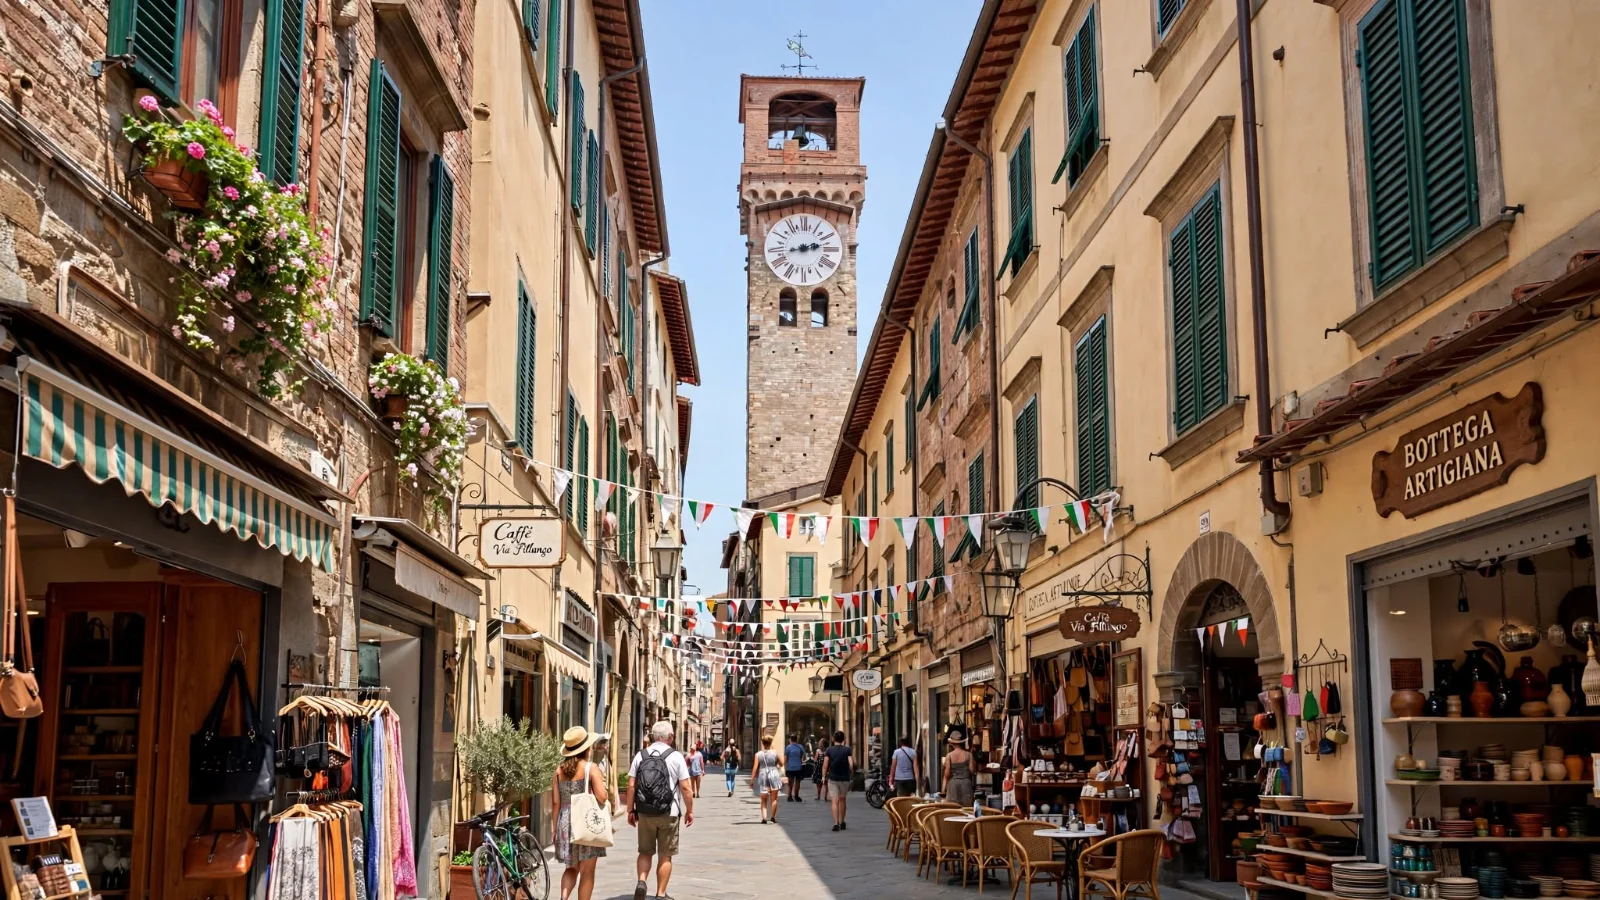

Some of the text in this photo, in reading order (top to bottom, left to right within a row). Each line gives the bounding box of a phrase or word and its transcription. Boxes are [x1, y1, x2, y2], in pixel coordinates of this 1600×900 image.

[1403, 410, 1494, 469] BOTTEGA
[1403, 441, 1504, 501] ARTIGIANA
[493, 544, 510, 555] Via
[1070, 620, 1085, 632] Via
